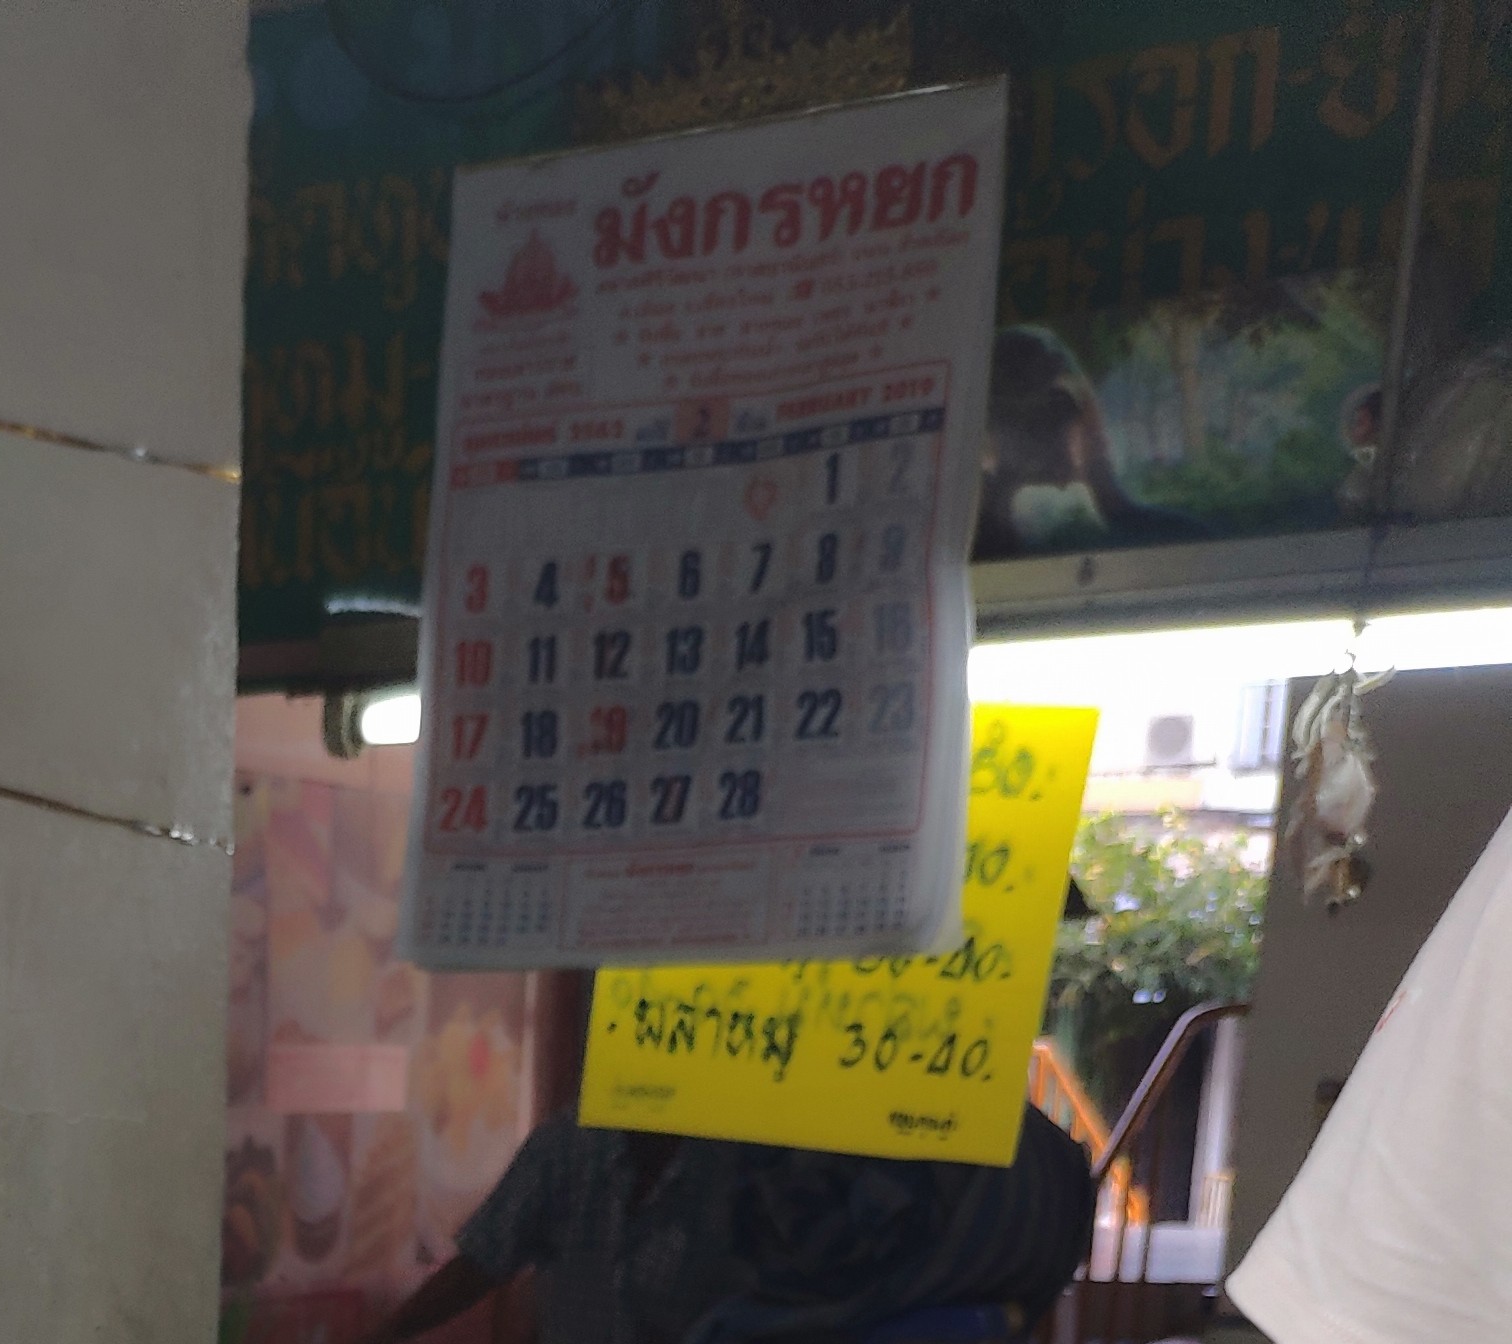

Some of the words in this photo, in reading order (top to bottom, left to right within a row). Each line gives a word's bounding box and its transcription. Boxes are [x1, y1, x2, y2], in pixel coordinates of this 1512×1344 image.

[593, 153, 979, 270] มังกรหยก
[825, 453, 841, 504] 1
[464, 566, 487, 613] 3
[534, 560, 558, 607] 4
[606, 555, 629, 604] 5
[678, 549, 701, 598] 6
[750, 543, 773, 593] 7
[815, 533, 838, 584] 8
[456, 641, 493, 688] 10
[528, 636, 557, 684] 11
[594, 631, 631, 680] 12
[665, 626, 706, 675] 13
[735, 620, 772, 671] 14
[803, 611, 838, 662] 15
[451, 713, 489, 760] 17
[521, 709, 558, 758] 18
[590, 705, 628, 755] 19
[653, 701, 699, 749] 20
[724, 695, 766, 744] 21
[795, 690, 843, 740] 22
[866, 682, 916, 734] 23
[439, 787, 488, 833] 24
[513, 783, 559, 833] 25
[582, 780, 628, 828] 26
[650, 774, 692, 824] 27
[718, 770, 763, 821] 28
